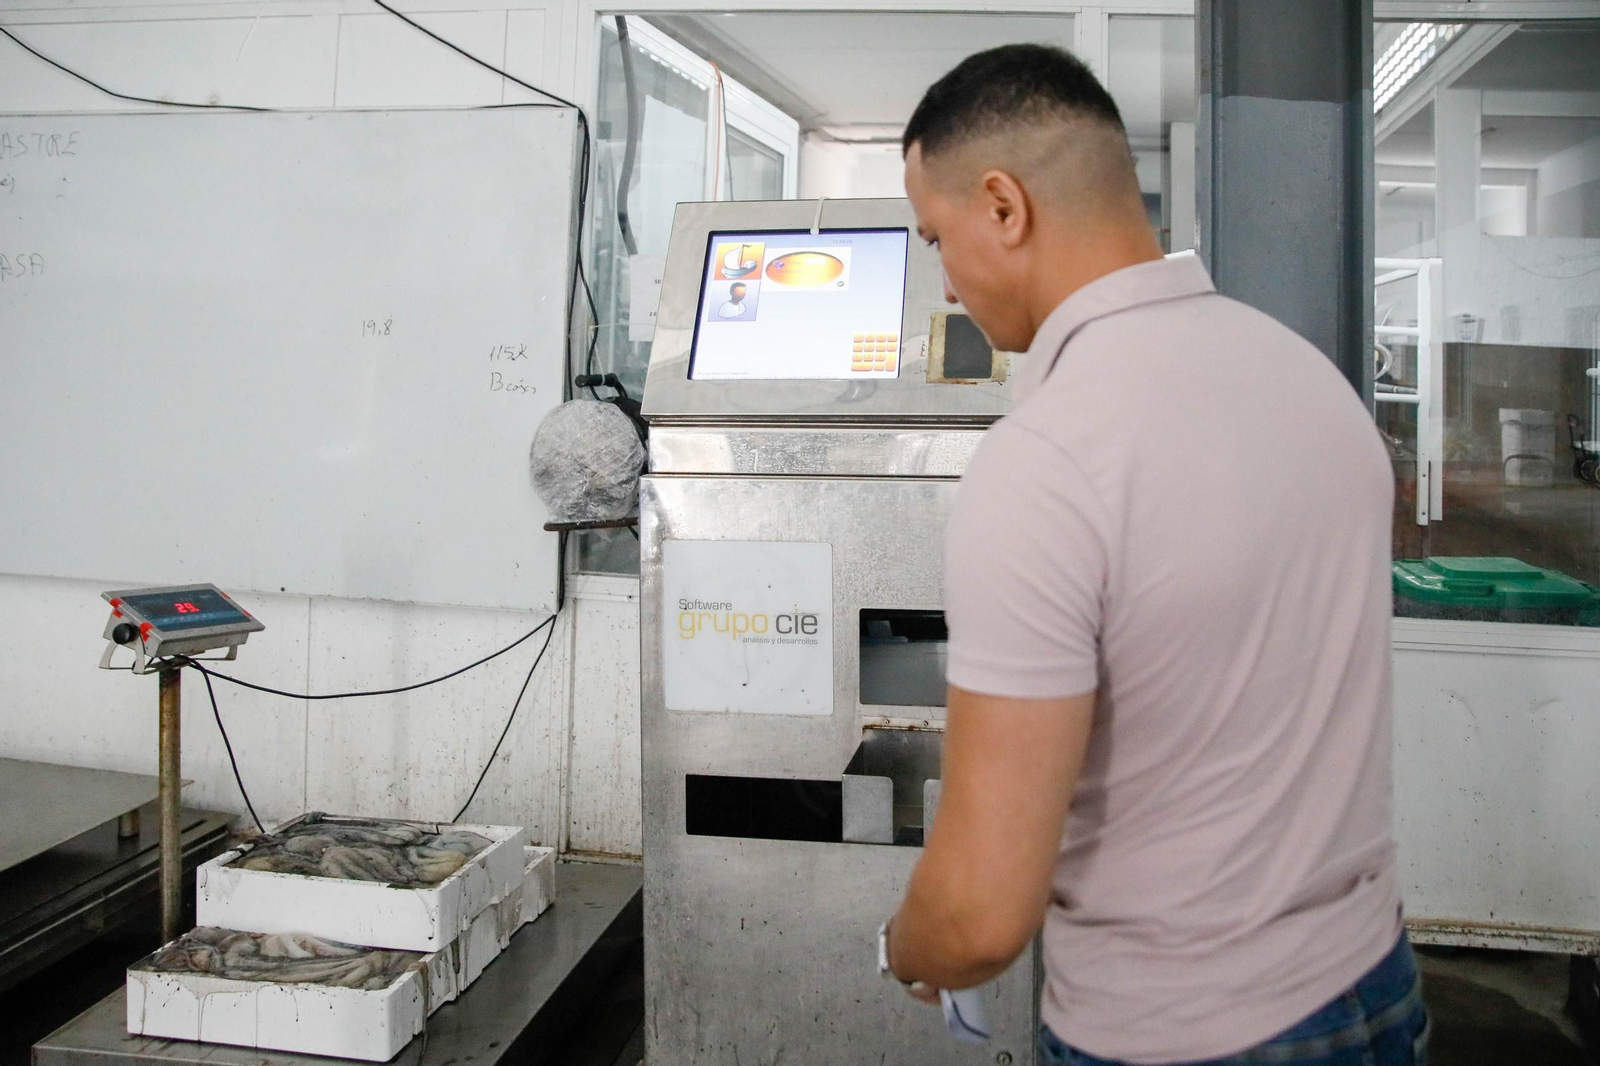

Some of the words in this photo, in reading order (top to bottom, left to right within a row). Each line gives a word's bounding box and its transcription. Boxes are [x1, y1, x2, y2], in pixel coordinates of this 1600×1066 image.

[678, 598, 733, 611] Software
[678, 611, 769, 641] grupo
[775, 608, 818, 635] cie
[776, 637, 818, 645] desarrollos
